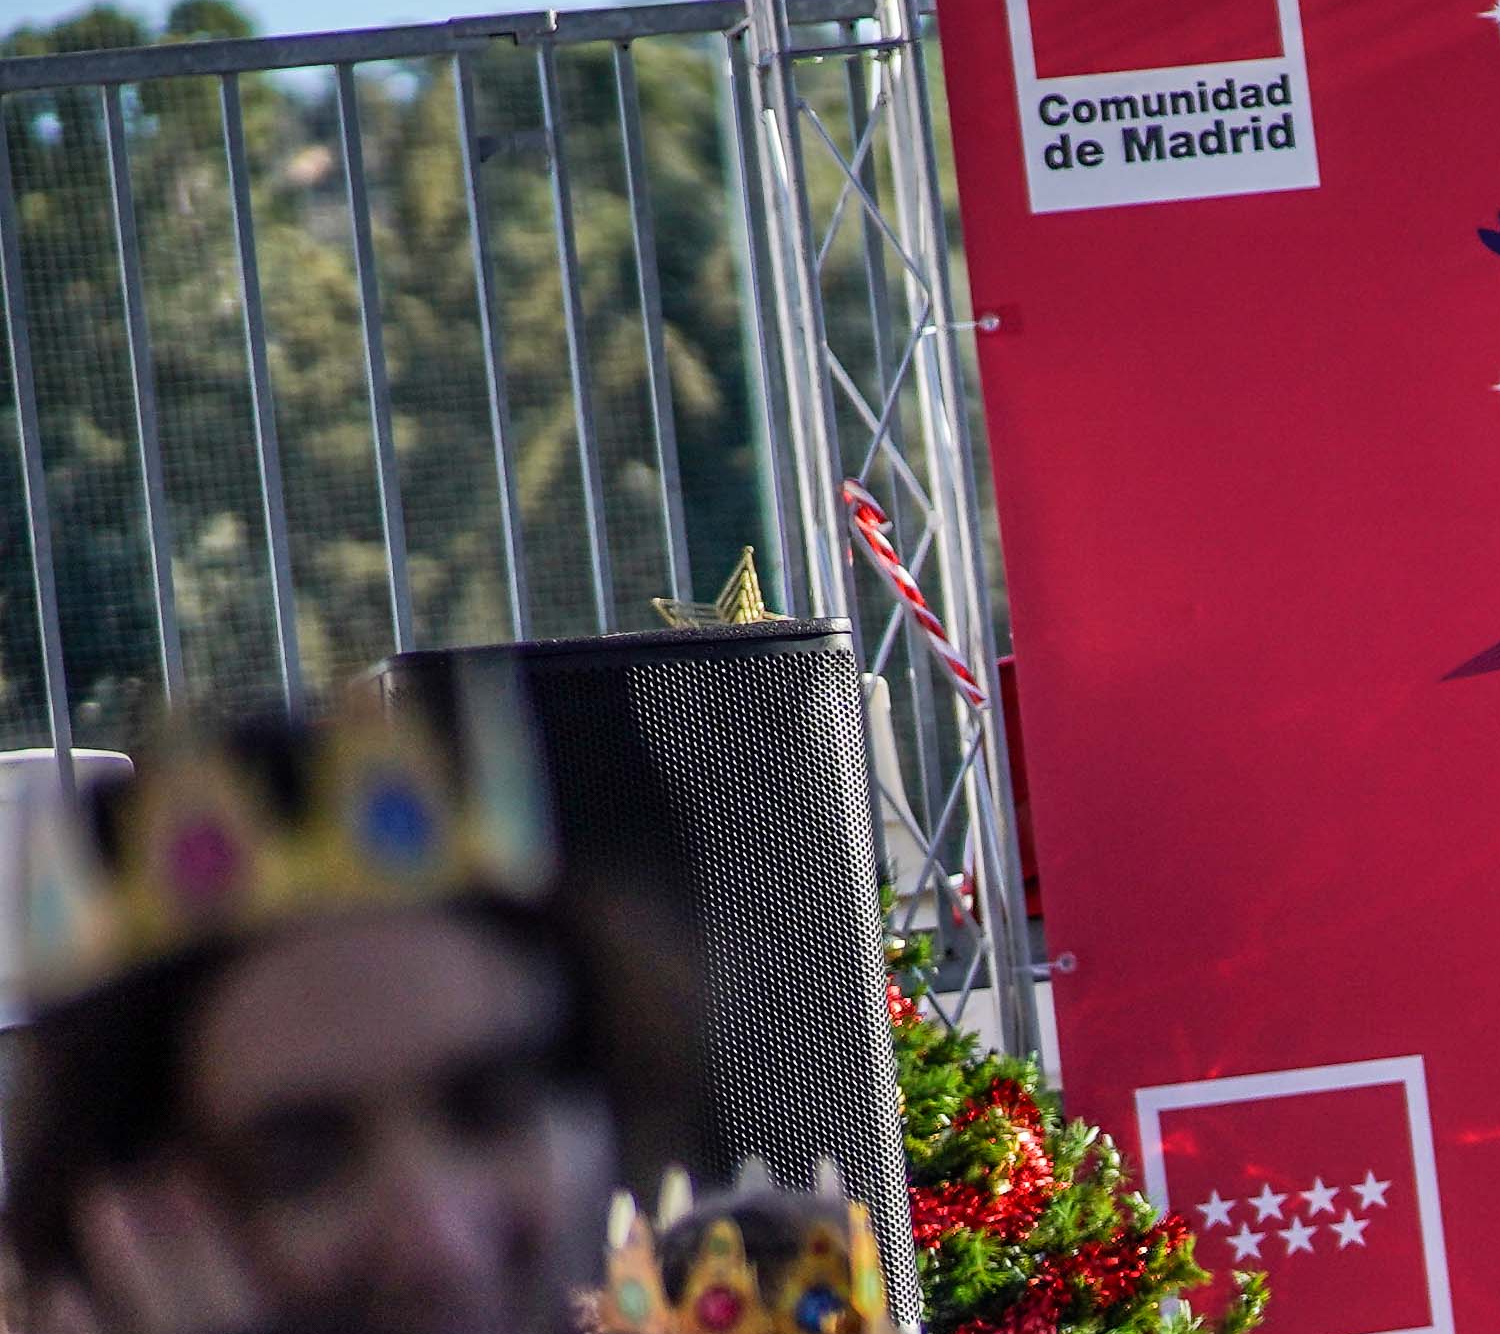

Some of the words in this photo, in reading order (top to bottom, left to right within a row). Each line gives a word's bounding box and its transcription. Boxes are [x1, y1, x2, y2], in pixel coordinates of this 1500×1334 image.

[1038, 74, 1293, 127] Comunidad
[1043, 133, 1104, 170] de
[1123, 113, 1297, 164] Madrid
